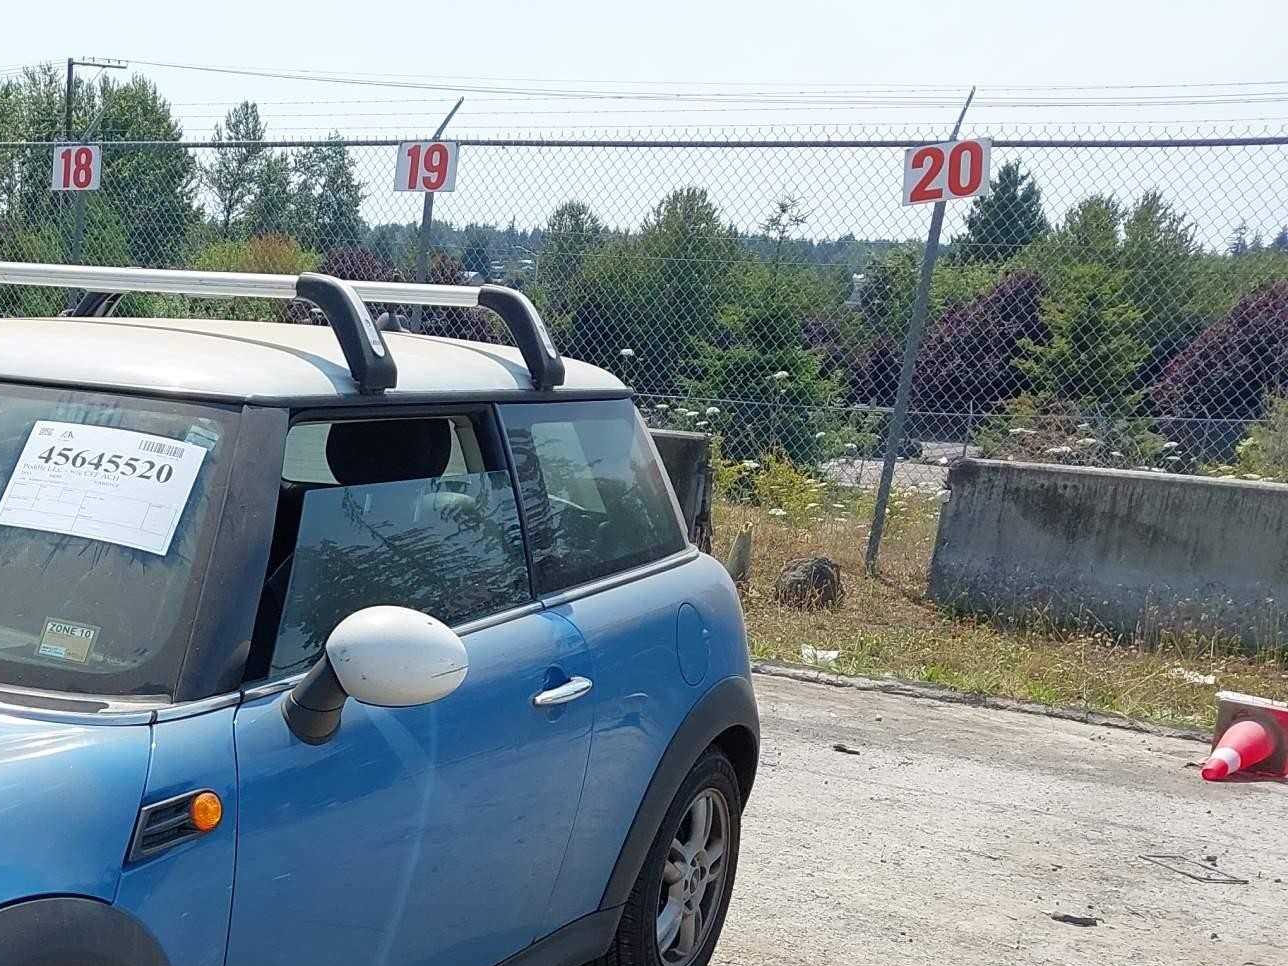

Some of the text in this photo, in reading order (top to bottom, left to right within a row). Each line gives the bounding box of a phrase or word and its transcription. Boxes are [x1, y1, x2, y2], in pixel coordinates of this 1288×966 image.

[61, 147, 93, 188] 18
[407, 142, 450, 190] 19
[910, 138, 985, 202] 20
[38, 446, 174, 483] 45645520
[49, 623, 91, 639] ZONE 10
